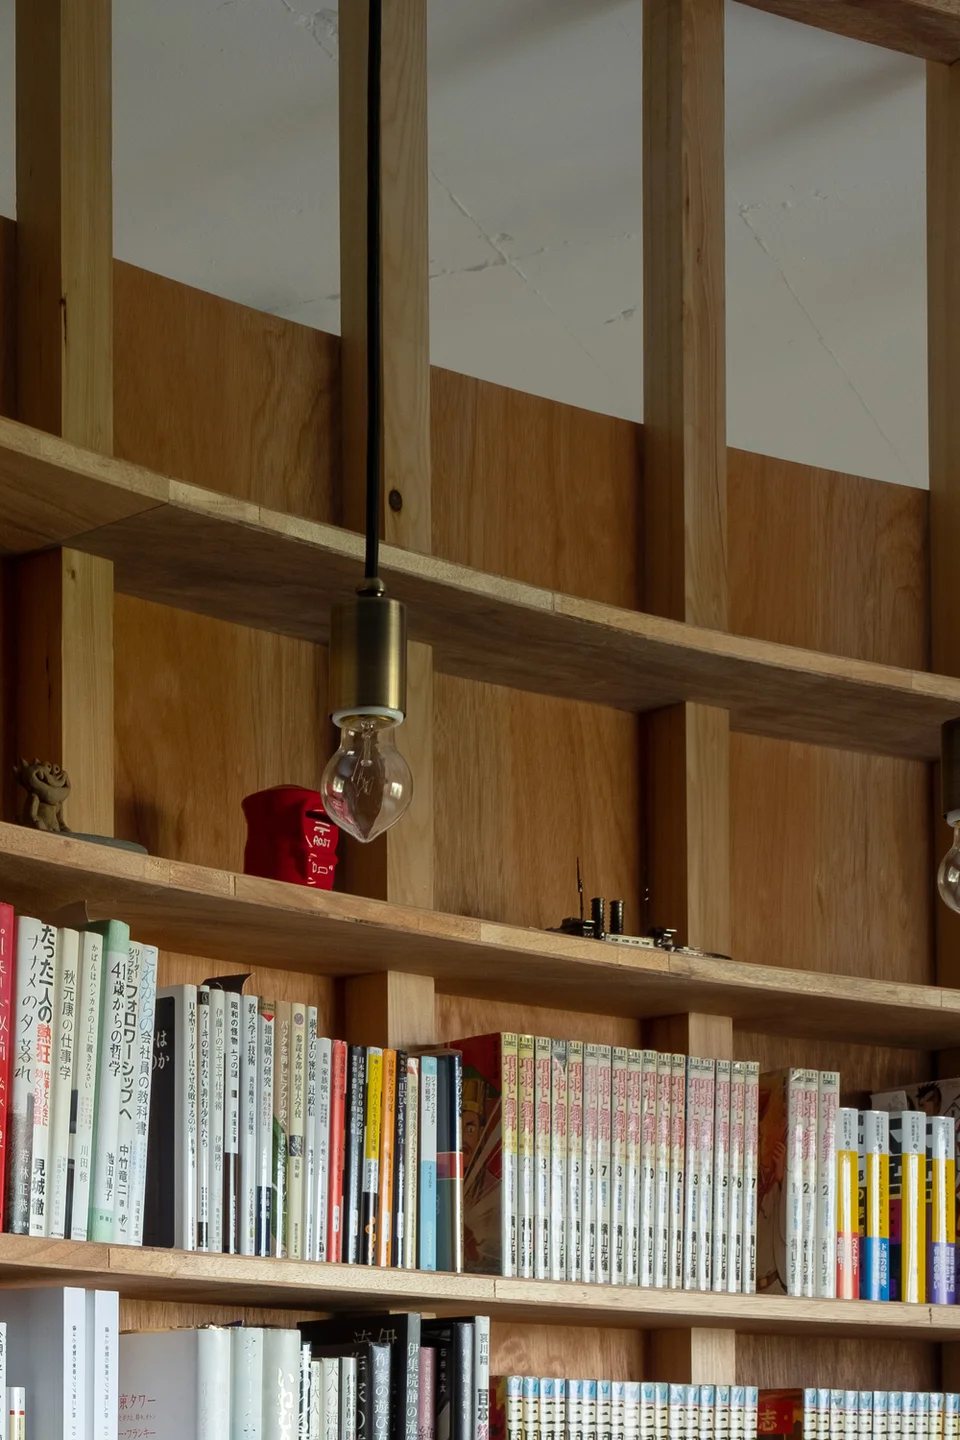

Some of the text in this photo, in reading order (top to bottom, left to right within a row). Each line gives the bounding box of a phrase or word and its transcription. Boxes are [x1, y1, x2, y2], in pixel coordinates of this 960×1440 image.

[14, 934, 39, 1083] ナナメの夕暮れ
[31, 925, 56, 1215] たった一人の熱狂 見城徹
[59, 969, 76, 1080] 秋元康の仕事学
[79, 944, 98, 1184] かばんはハンカチの上に置きなさい 川田修
[104, 961, 126, 1201] 41歳からの哲学 池田晶子
[135, 948, 156, 1136] これからの会社員の教科書
[200, 1010, 209, 1149] ケーキの切れない非行少年たち
[230, 1001, 238, 1045] 昭和の怪物
[247, 1003, 257, 1066] 教え学ぶ技術
[263, 1024, 273, 1087] 撤退戦の研究
[279, 1020, 289, 1127] バッタを倒しにアフリカへ
[118, 983, 138, 1195] フォロワーシップへ 中竹竜二
[214, 1007, 224, 1171] 伊藤Pのモヤモヤ仕事術 伊藤隆行
